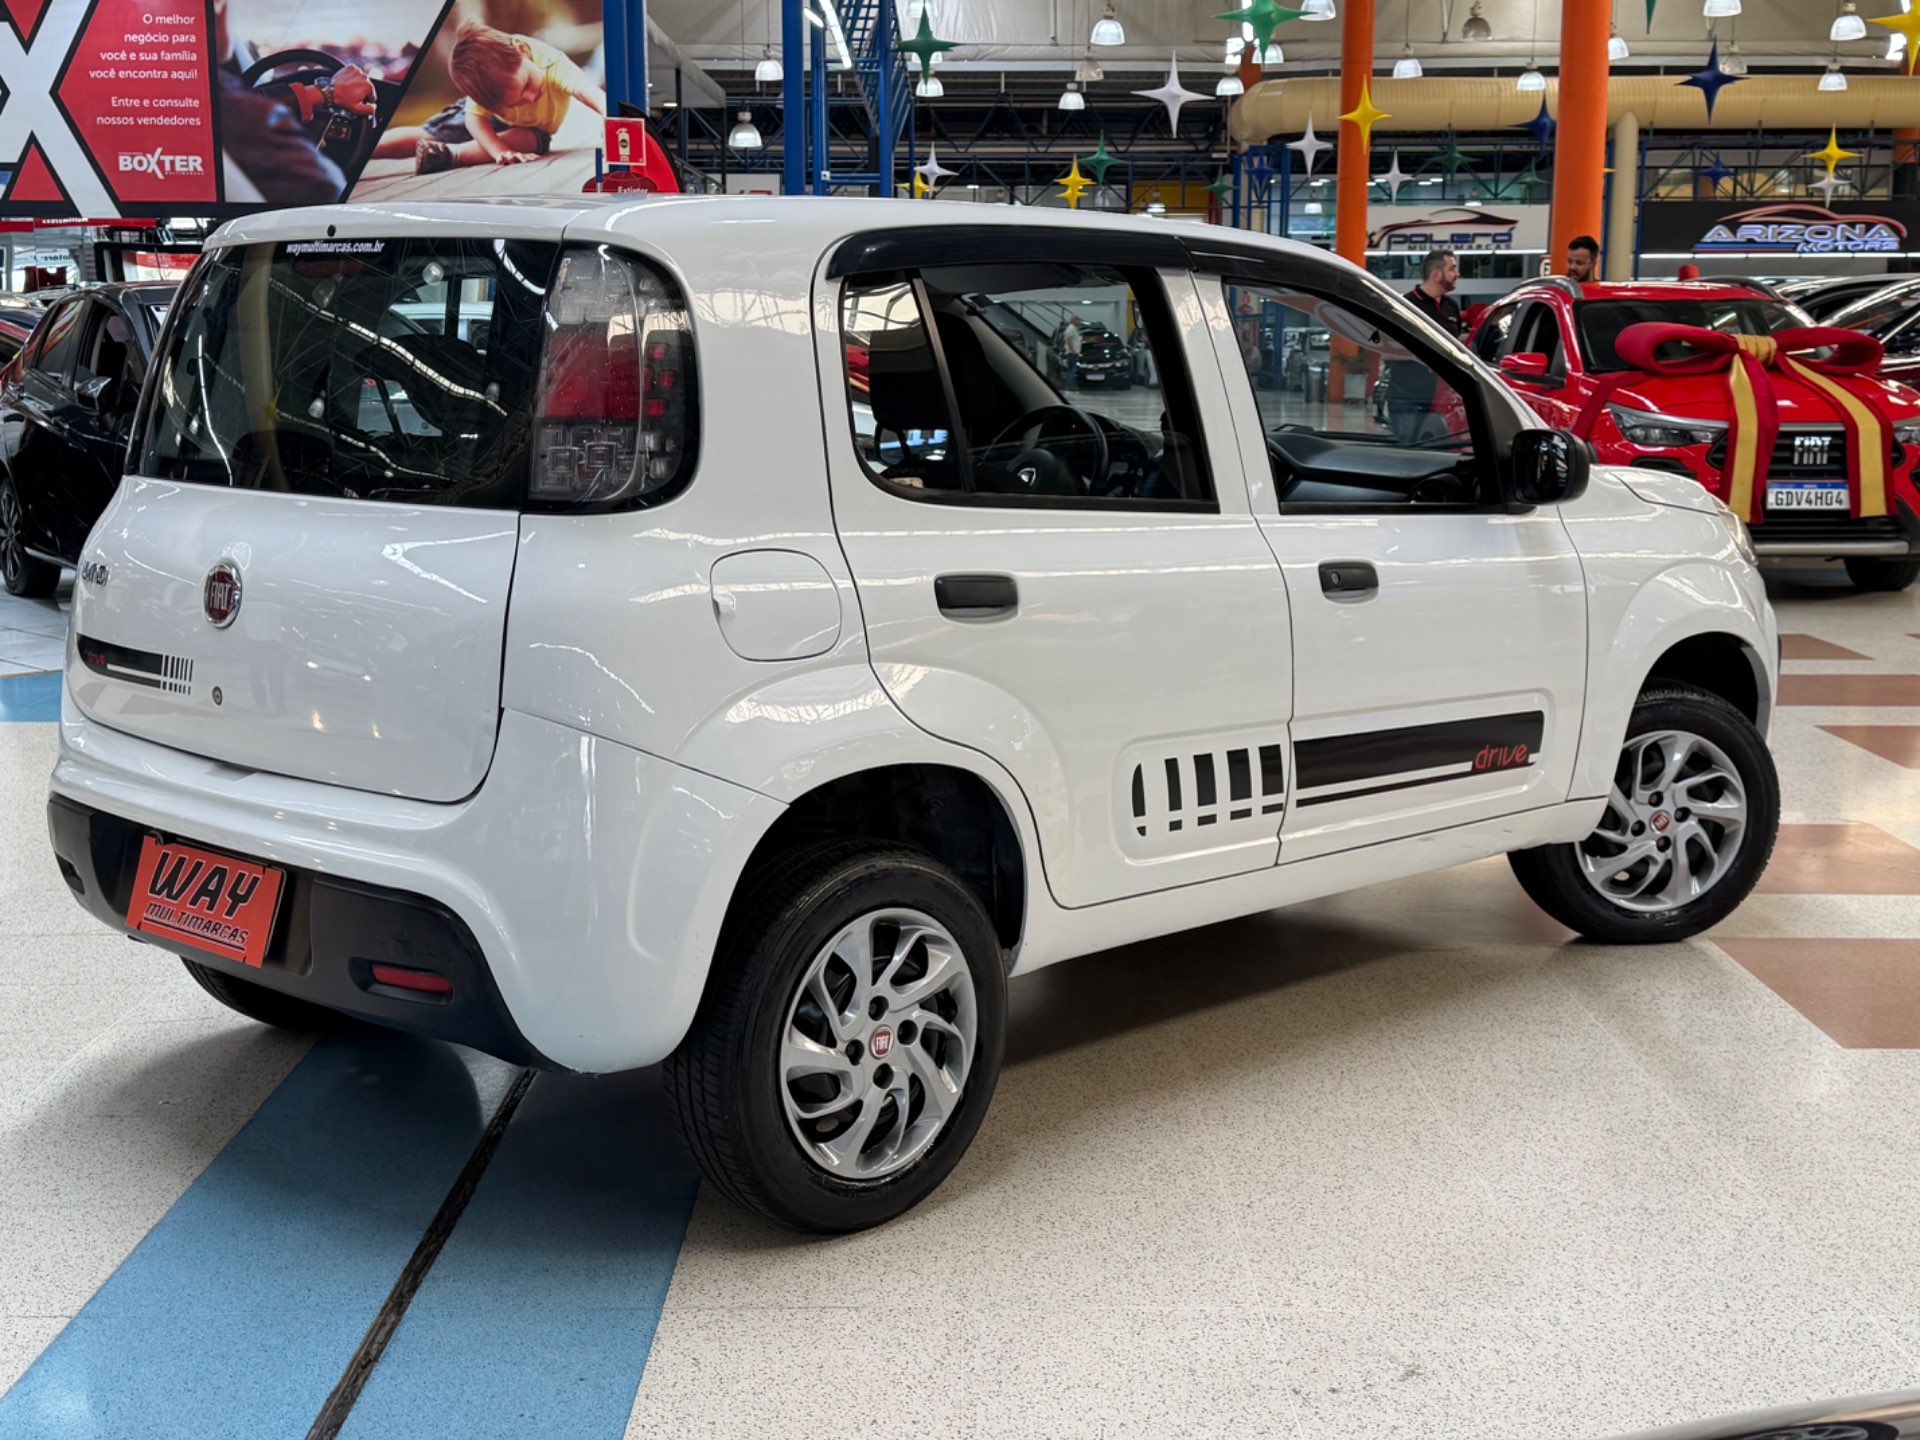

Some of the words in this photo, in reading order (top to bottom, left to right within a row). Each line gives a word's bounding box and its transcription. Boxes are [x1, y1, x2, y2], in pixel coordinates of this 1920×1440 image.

[142, 13, 153, 25] O
[155, 14, 196, 25] melhor
[124, 32, 170, 45] negócio
[171, 34, 196, 45] para
[100, 50, 127, 61] você
[129, 53, 137, 61] e
[139, 52, 158, 61] sua
[89, 68, 116, 79] você
[118, 69, 169, 79] encontra
[170, 69, 199, 81] aqui!
[111, 96, 140, 107] Entre
[142, 99, 150, 107] e
[152, 98, 200, 108] consulte
[96, 116, 134, 125] nossos
[137, 115, 201, 126] vendedores
[118, 147, 204, 180] BOXTER
[1700, 224, 1901, 243] ARIZONA
[286, 240, 386, 256] waymultimarcas.com.br
[1795, 241, 1899, 252] MOTORS
[1793, 436, 1832, 465] FIAT
[209, 581, 232, 610] FIAT
[1474, 743, 1529, 770] drive
[147, 850, 263, 919] WAY
[145, 902, 249, 945] MULTIMARCAS
